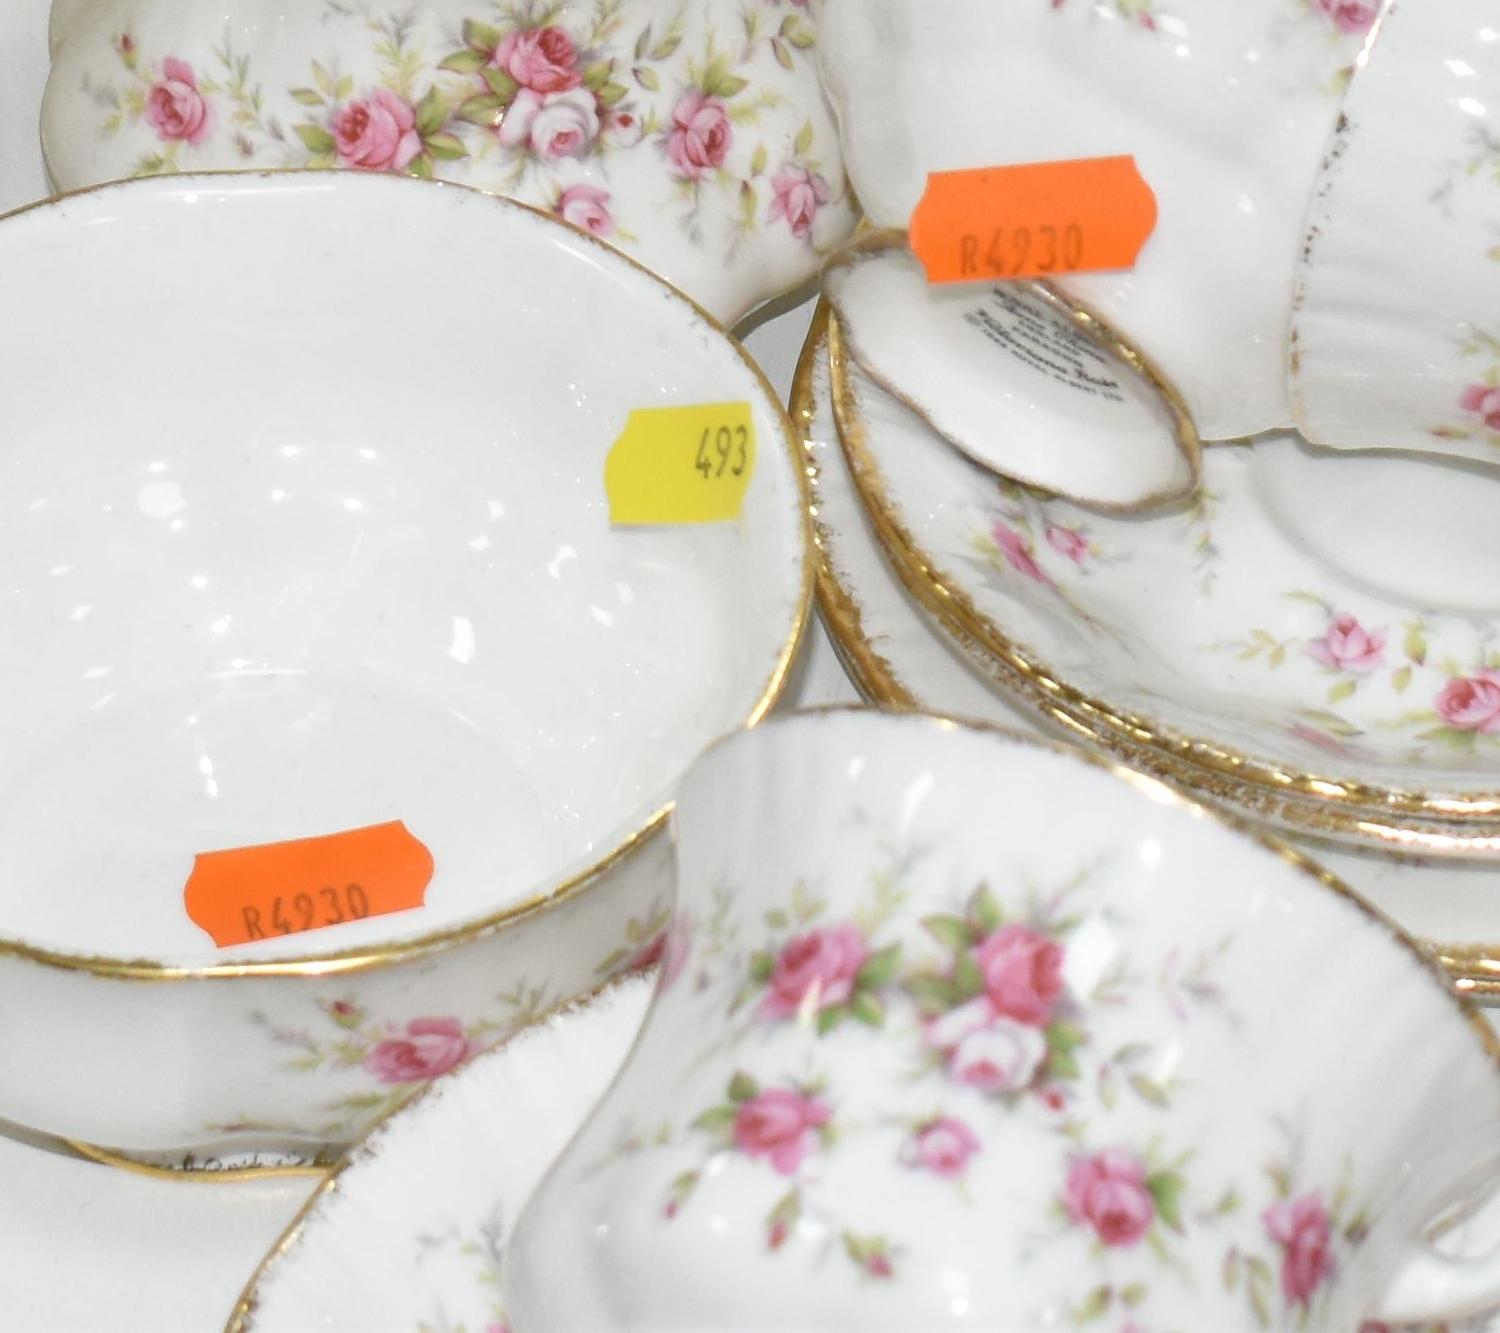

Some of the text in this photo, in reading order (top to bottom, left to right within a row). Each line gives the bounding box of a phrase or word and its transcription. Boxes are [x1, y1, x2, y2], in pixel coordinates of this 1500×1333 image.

[959, 222, 1084, 280] R4930
[694, 423, 749, 480] 493
[240, 882, 370, 941] R4930
